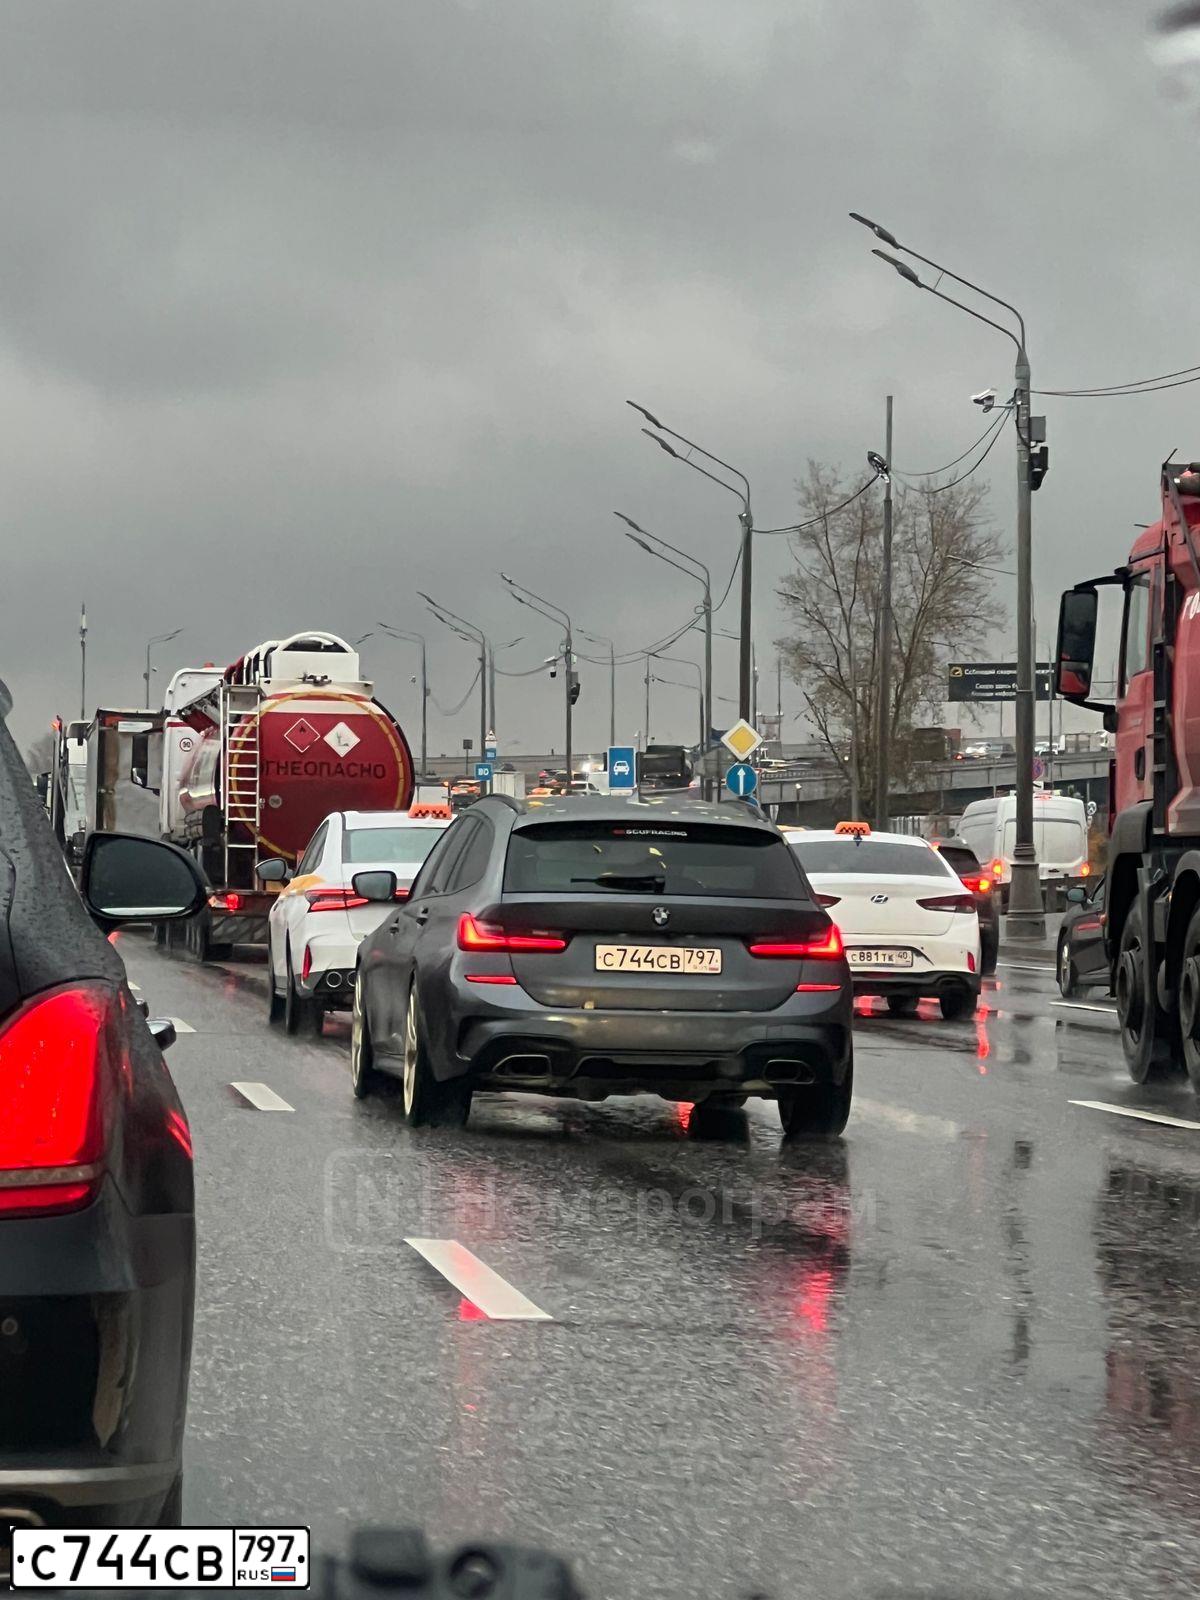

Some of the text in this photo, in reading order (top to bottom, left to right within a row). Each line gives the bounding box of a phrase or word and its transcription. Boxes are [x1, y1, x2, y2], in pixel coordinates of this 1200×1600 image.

[603, 948, 716, 970] С744СВ 797
[851, 951, 908, 962] С881ТК 40
